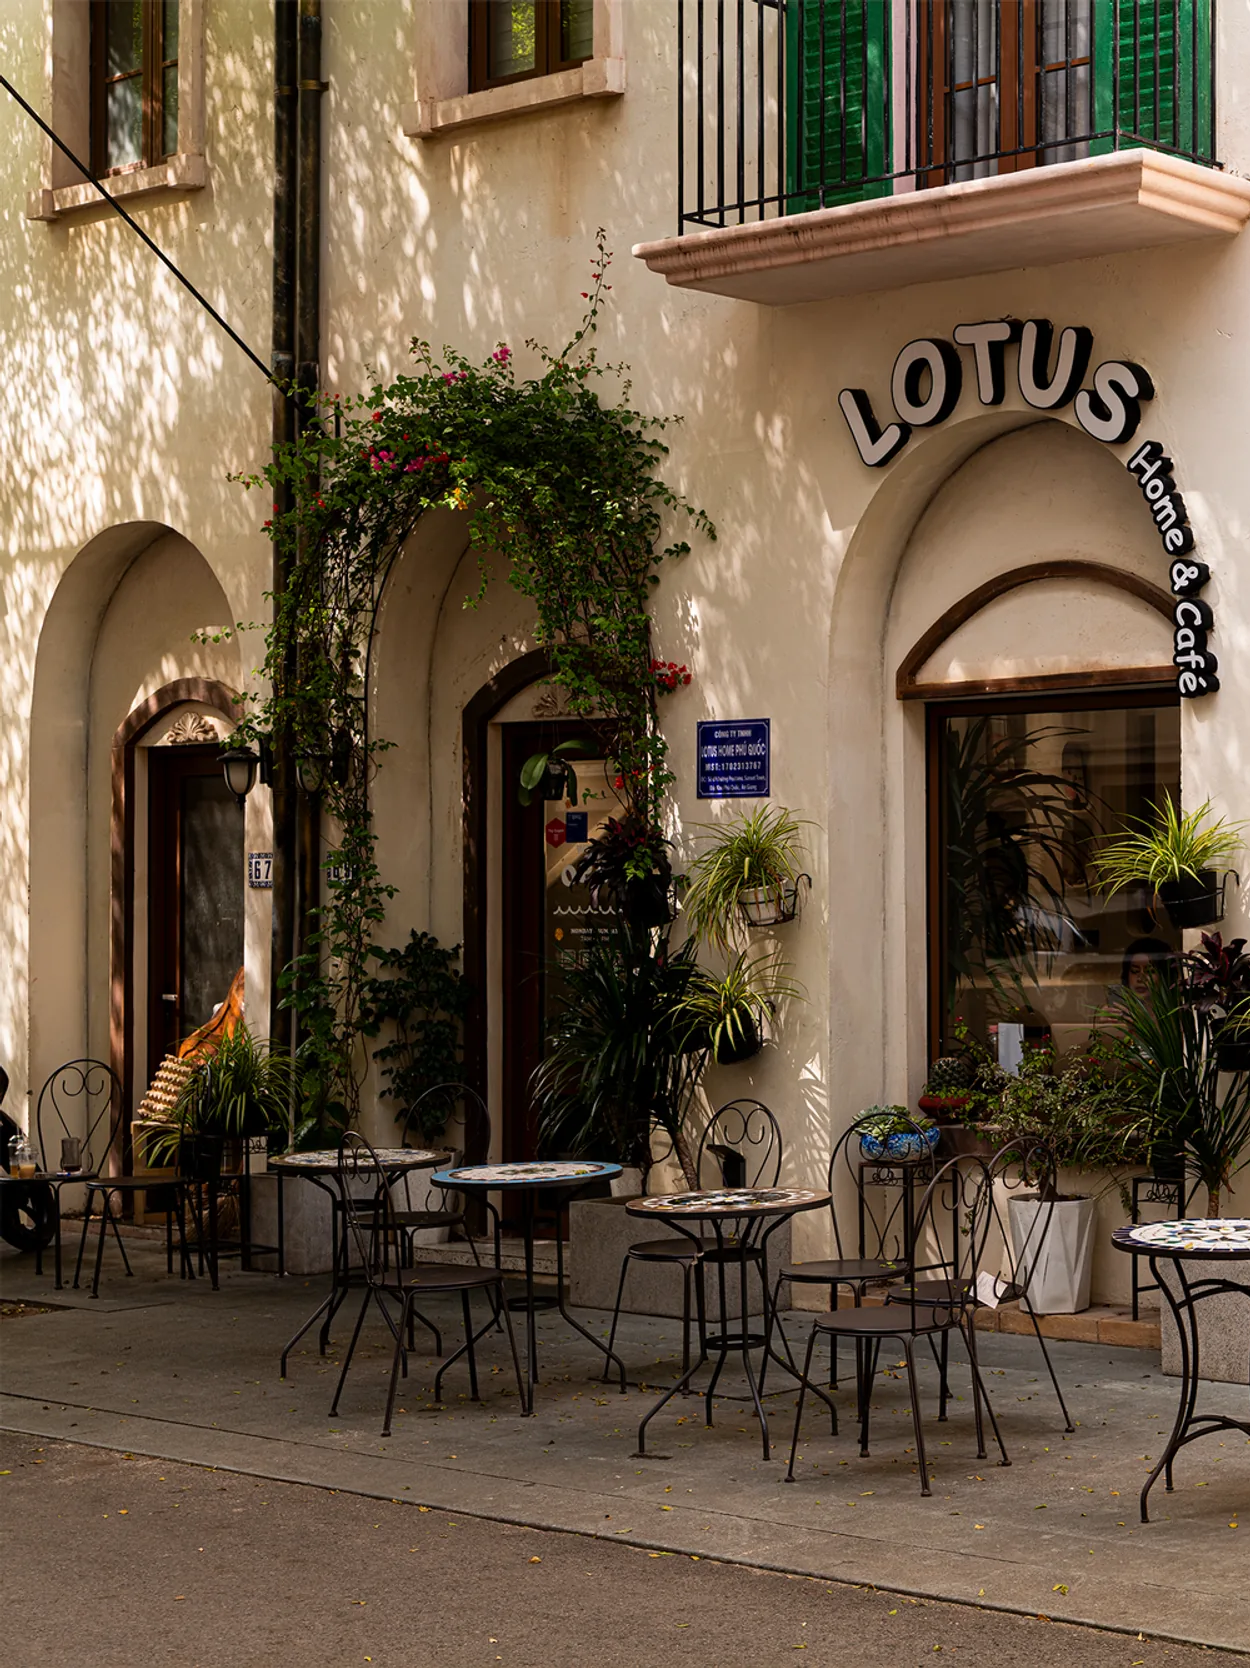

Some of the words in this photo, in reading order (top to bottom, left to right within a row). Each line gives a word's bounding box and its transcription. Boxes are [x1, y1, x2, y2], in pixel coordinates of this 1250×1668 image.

[838, 318, 1154, 467] LOTUS
[1127, 440, 1194, 556] Home
[1169, 558, 1211, 596] &
[1173, 599, 1221, 699] Café
[718, 744, 734, 757] HOME
[254, 860, 272, 880] 67
